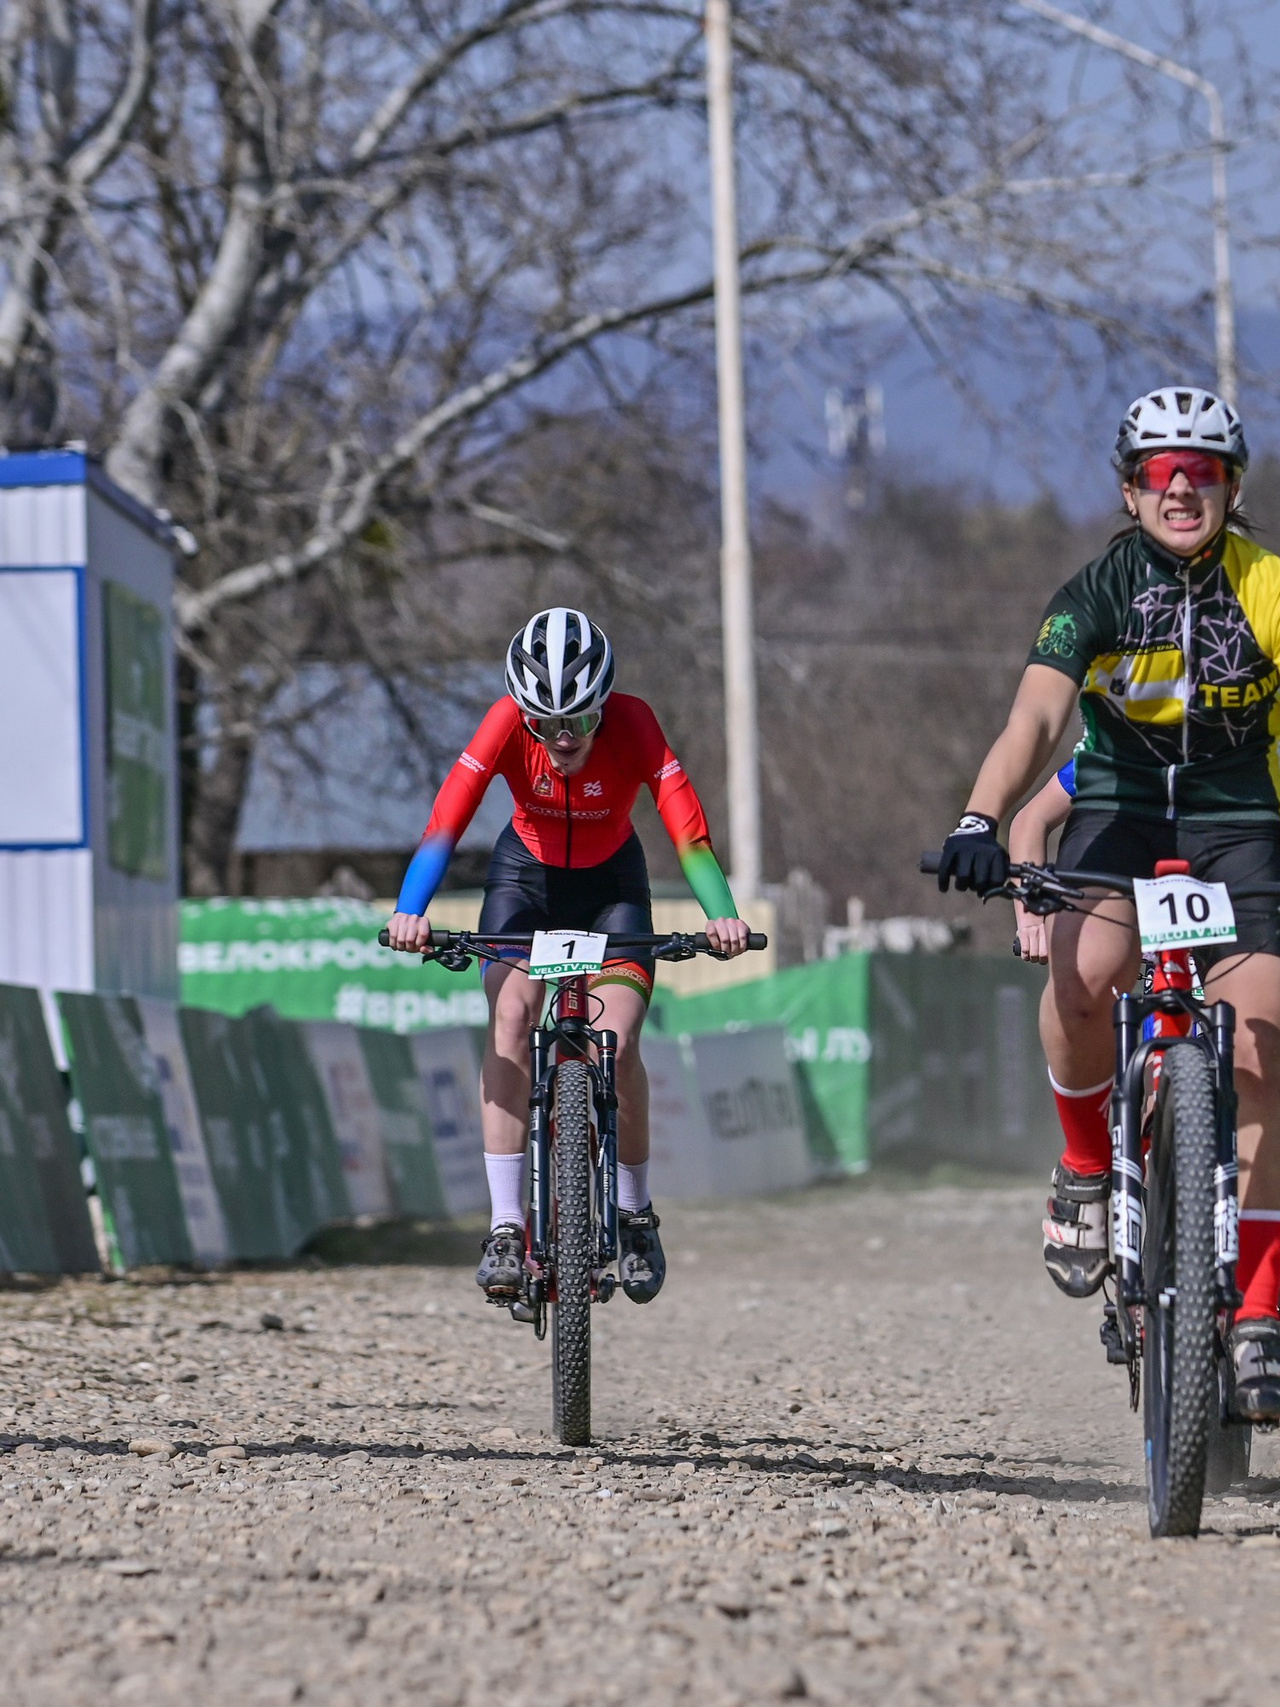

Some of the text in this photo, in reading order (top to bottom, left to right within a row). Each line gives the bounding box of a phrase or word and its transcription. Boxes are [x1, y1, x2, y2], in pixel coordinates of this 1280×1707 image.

[1198, 668, 1280, 708] TEAM
[525, 802, 611, 817] MOSCOW
[1158, 892, 1210, 925] 10
[561, 939, 576, 959] 1
